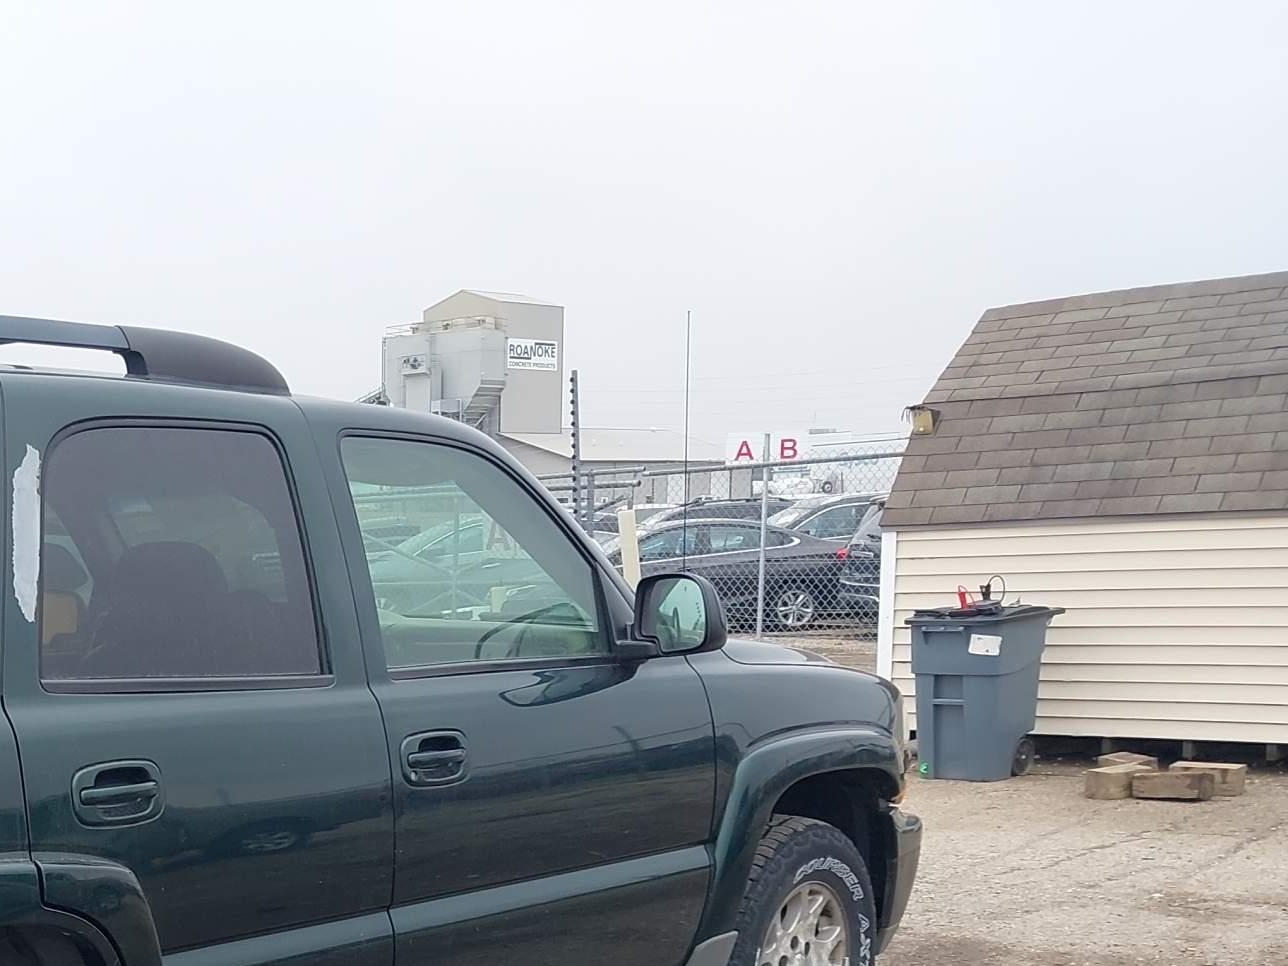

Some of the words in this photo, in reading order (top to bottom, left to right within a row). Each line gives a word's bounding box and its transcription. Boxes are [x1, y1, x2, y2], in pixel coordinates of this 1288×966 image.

[509, 342, 556, 359] ROANOKE
[734, 440, 754, 461] A
[779, 438, 798, 459] B
